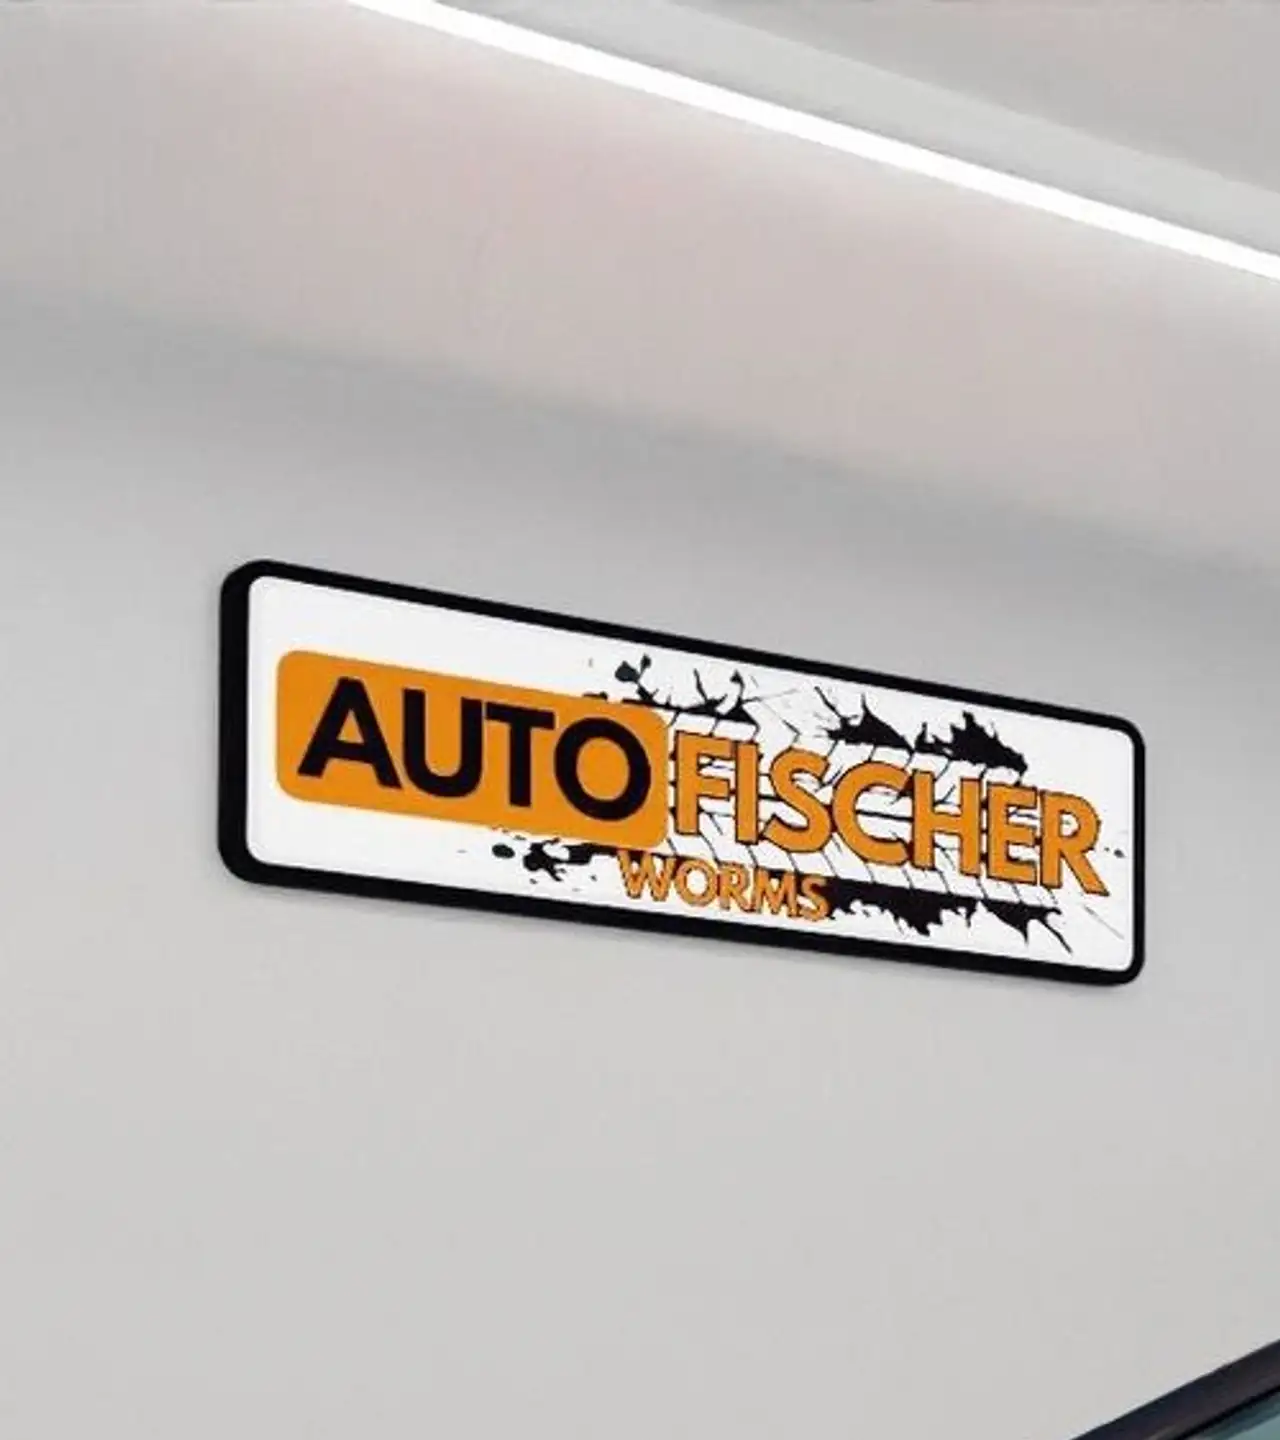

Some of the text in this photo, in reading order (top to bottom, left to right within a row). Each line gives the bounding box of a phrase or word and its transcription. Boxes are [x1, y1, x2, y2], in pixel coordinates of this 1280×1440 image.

[296, 677, 1111, 895] AUTO FISCHER
[617, 848, 831, 922] WORMS
